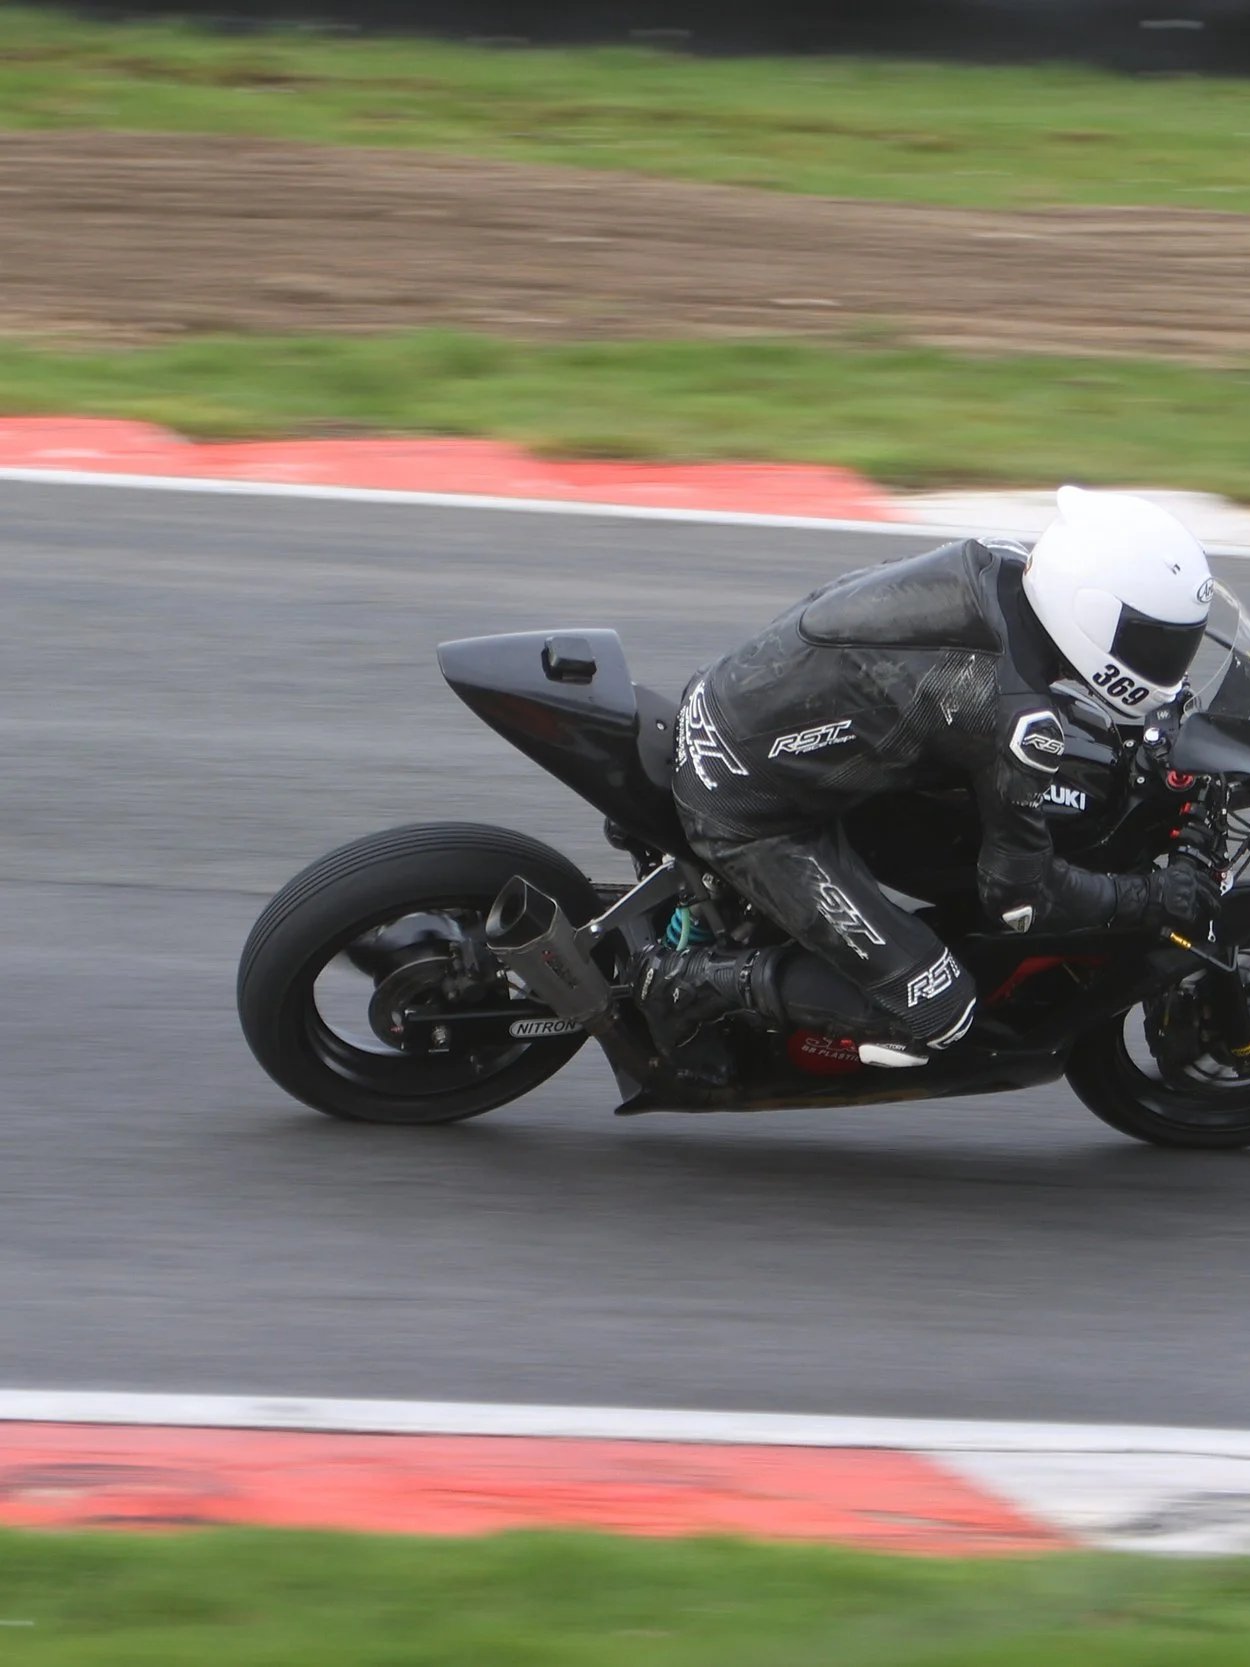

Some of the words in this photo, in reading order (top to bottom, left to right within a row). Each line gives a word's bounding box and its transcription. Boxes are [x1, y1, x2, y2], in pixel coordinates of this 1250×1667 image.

[1092, 664, 1150, 706] 369
[768, 719, 852, 758] RST
[516, 1020, 576, 1035] NITRON
